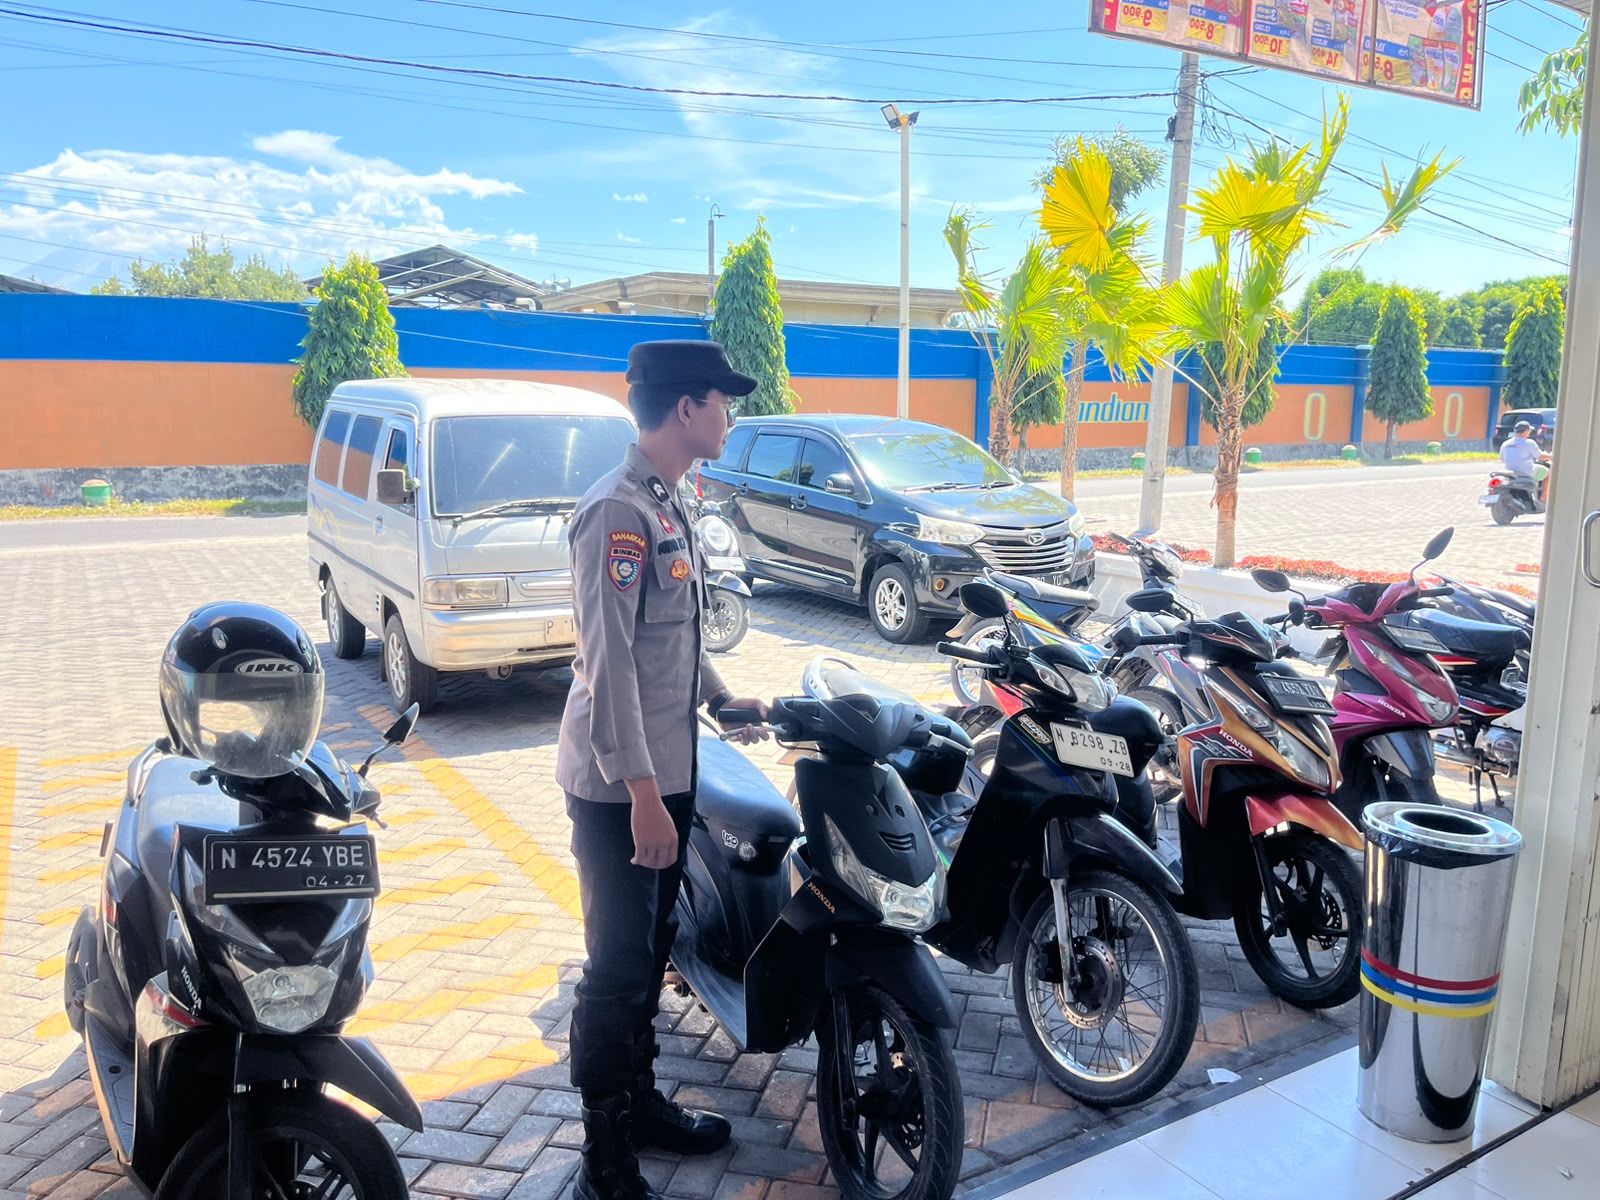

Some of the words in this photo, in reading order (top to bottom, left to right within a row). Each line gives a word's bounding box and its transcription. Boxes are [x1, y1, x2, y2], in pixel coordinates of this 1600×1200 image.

[245, 663, 295, 673] INK
[1377, 699, 1407, 718] HONDA
[1056, 727, 1065, 742] N
[1218, 729, 1254, 758] HONDA
[221, 847, 237, 869] N
[251, 846, 313, 869] 4524
[322, 845, 365, 867] YBE
[807, 881, 836, 914] HONDA
[181, 965, 202, 1010] HONDA
